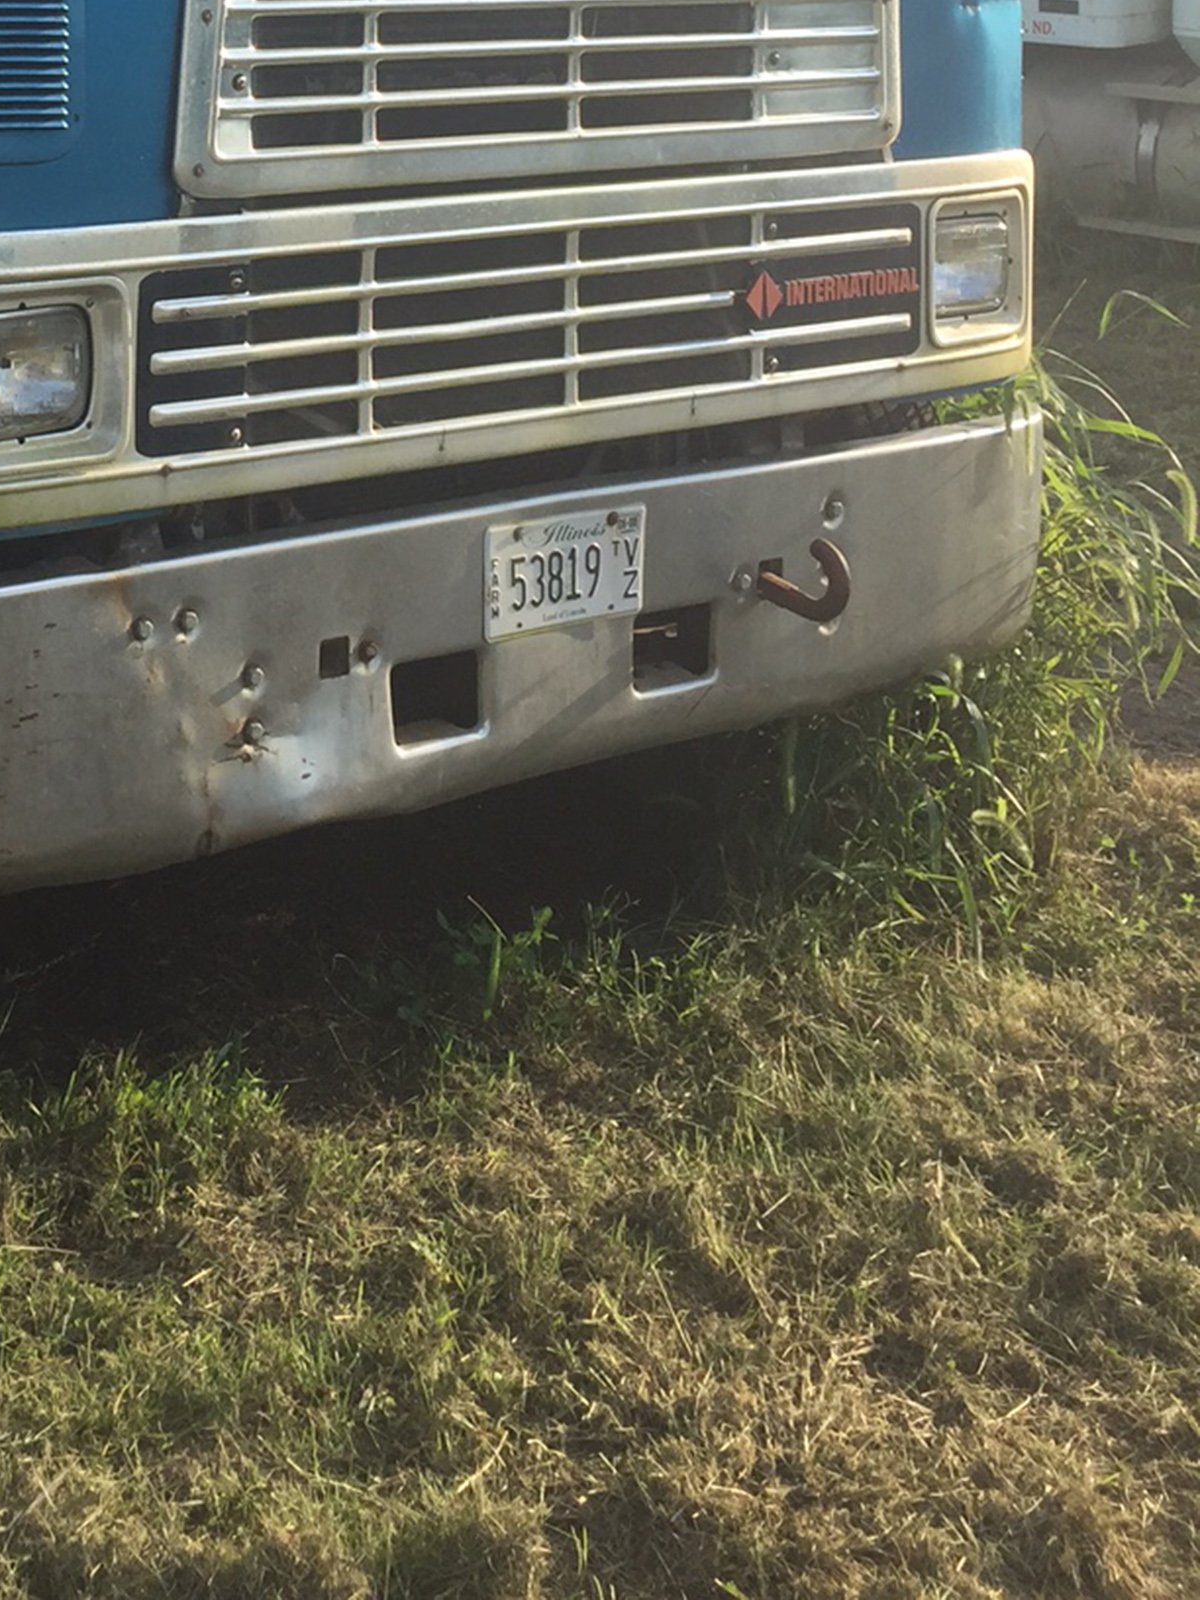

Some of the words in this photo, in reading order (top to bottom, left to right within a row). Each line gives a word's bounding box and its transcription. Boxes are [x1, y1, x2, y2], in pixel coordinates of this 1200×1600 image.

[784, 267, 920, 307] INTERNATIONAL
[524, 522, 606, 549] Illinois
[510, 542, 601, 612] 53819
